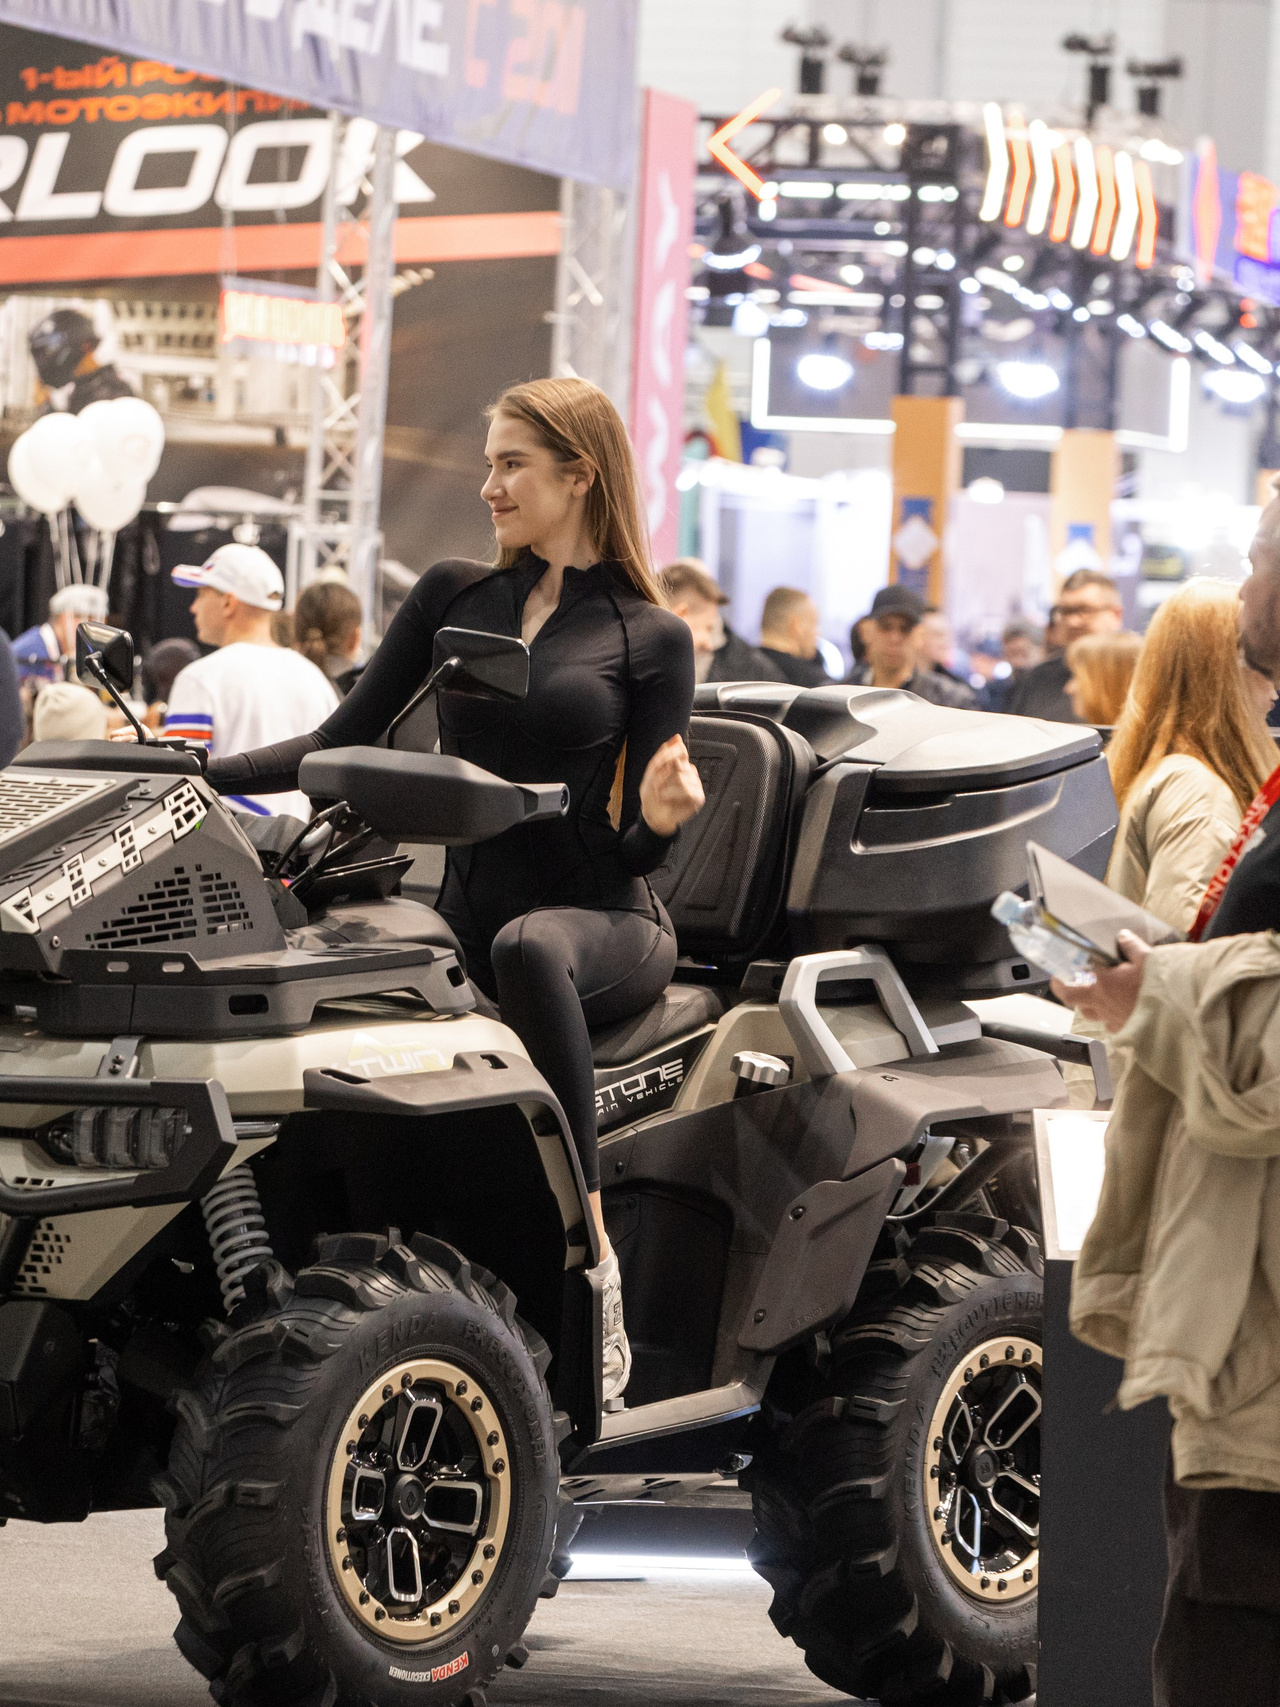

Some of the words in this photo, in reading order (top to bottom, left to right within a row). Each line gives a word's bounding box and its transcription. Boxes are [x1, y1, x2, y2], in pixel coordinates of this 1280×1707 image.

[627, 1076, 684, 1103] VEHICLE
[388, 1665, 431, 1683] EXECUTIONER
[430, 1650, 469, 1683] KENDA
